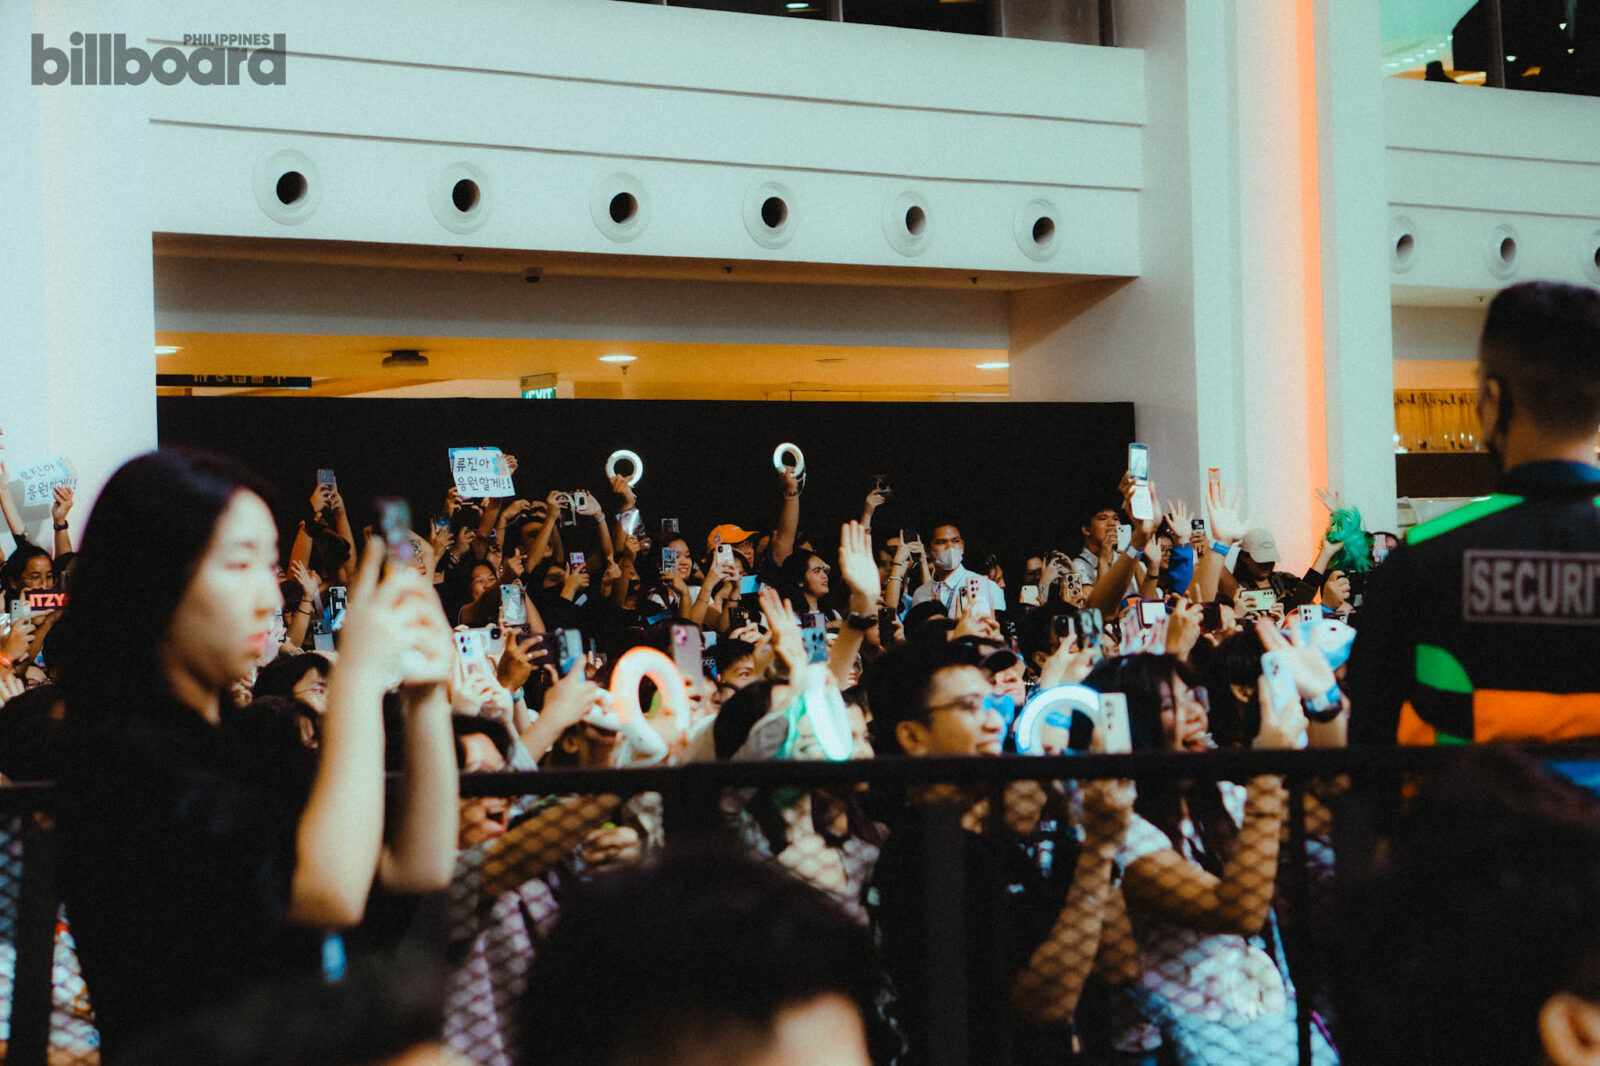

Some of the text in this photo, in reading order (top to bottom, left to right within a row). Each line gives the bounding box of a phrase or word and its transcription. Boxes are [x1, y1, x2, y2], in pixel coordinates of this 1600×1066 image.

[457, 457, 490, 472] 류진아
[457, 476, 511, 492] 응원할게!!
[1471, 559, 1600, 615] SECURI
[29, 593, 66, 607] ITZY
